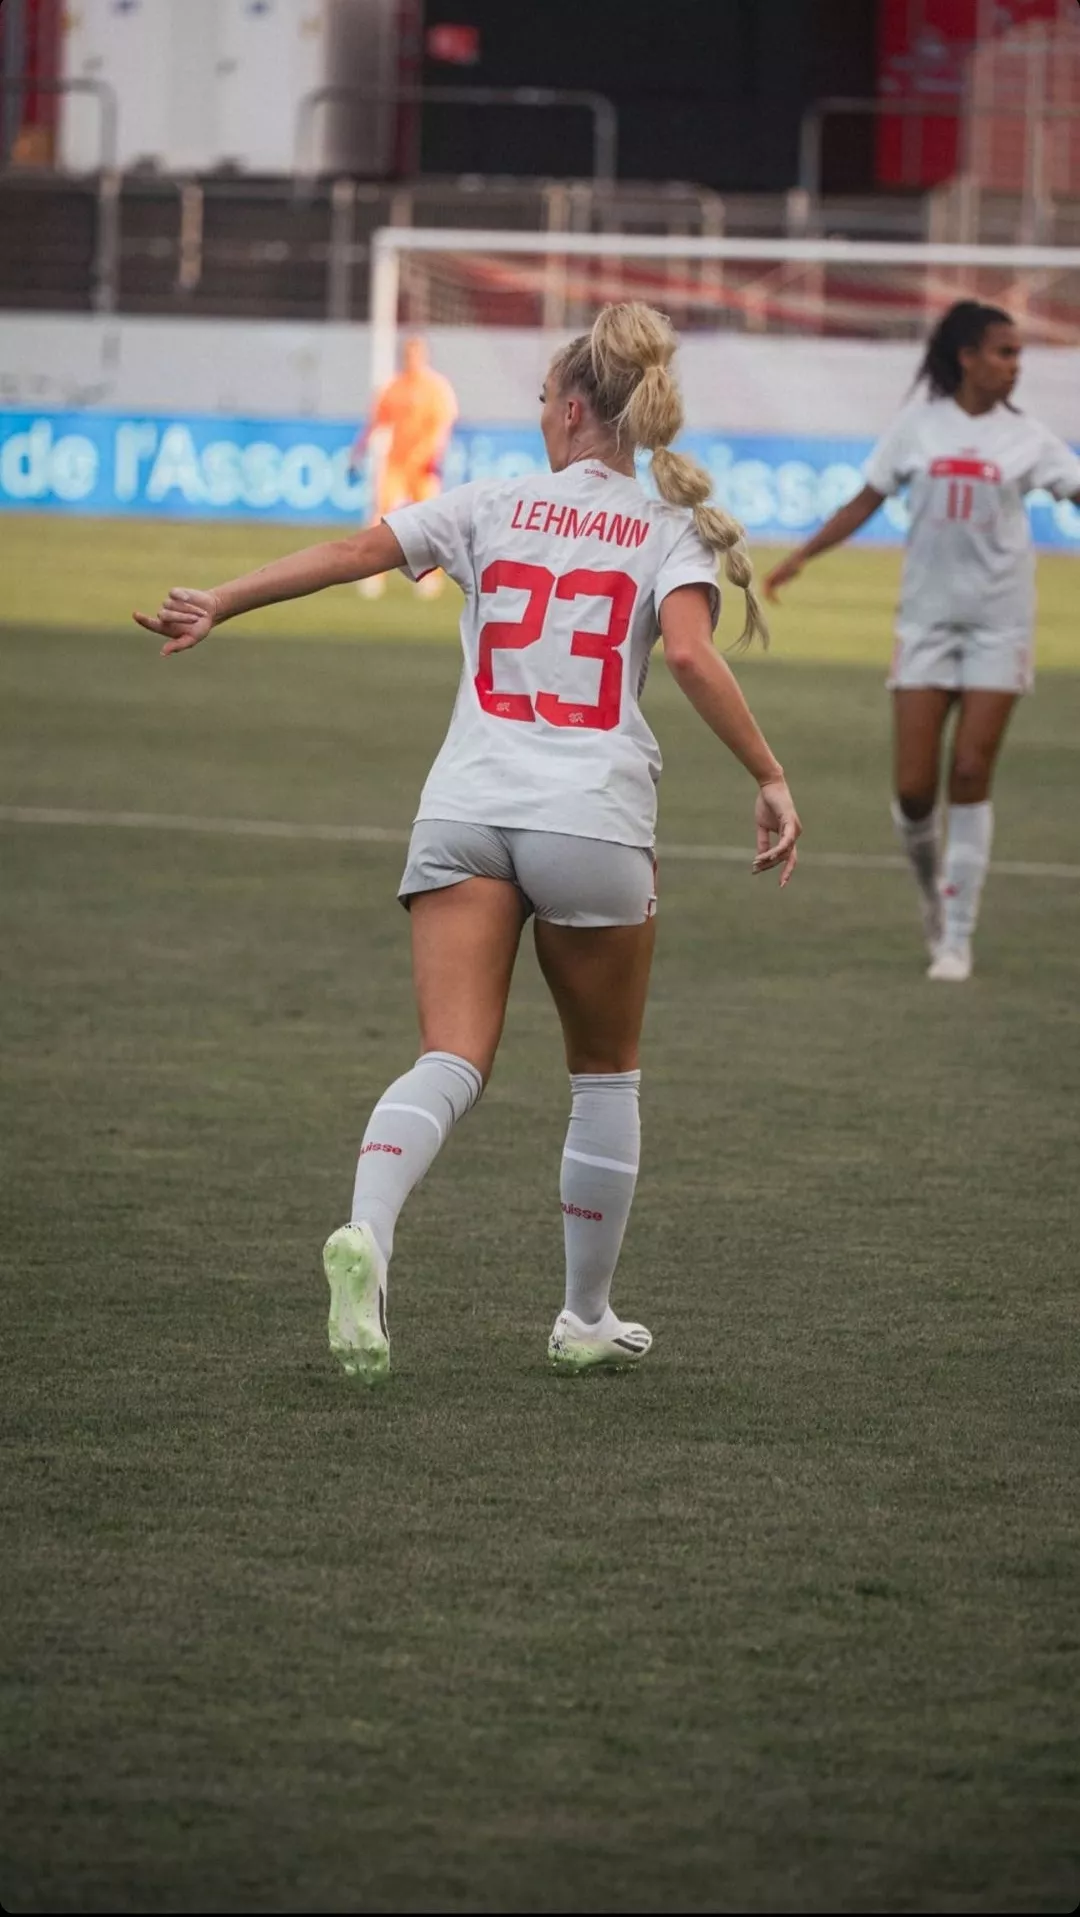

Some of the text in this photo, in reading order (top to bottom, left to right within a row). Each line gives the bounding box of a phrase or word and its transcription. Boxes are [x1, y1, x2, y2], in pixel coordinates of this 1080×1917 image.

[1, 419, 98, 500] de
[510, 500, 650, 549] LEHMANN
[947, 480, 973, 520] 11
[473, 558, 638, 732] 23
[359, 1141, 403, 1156] uisse
